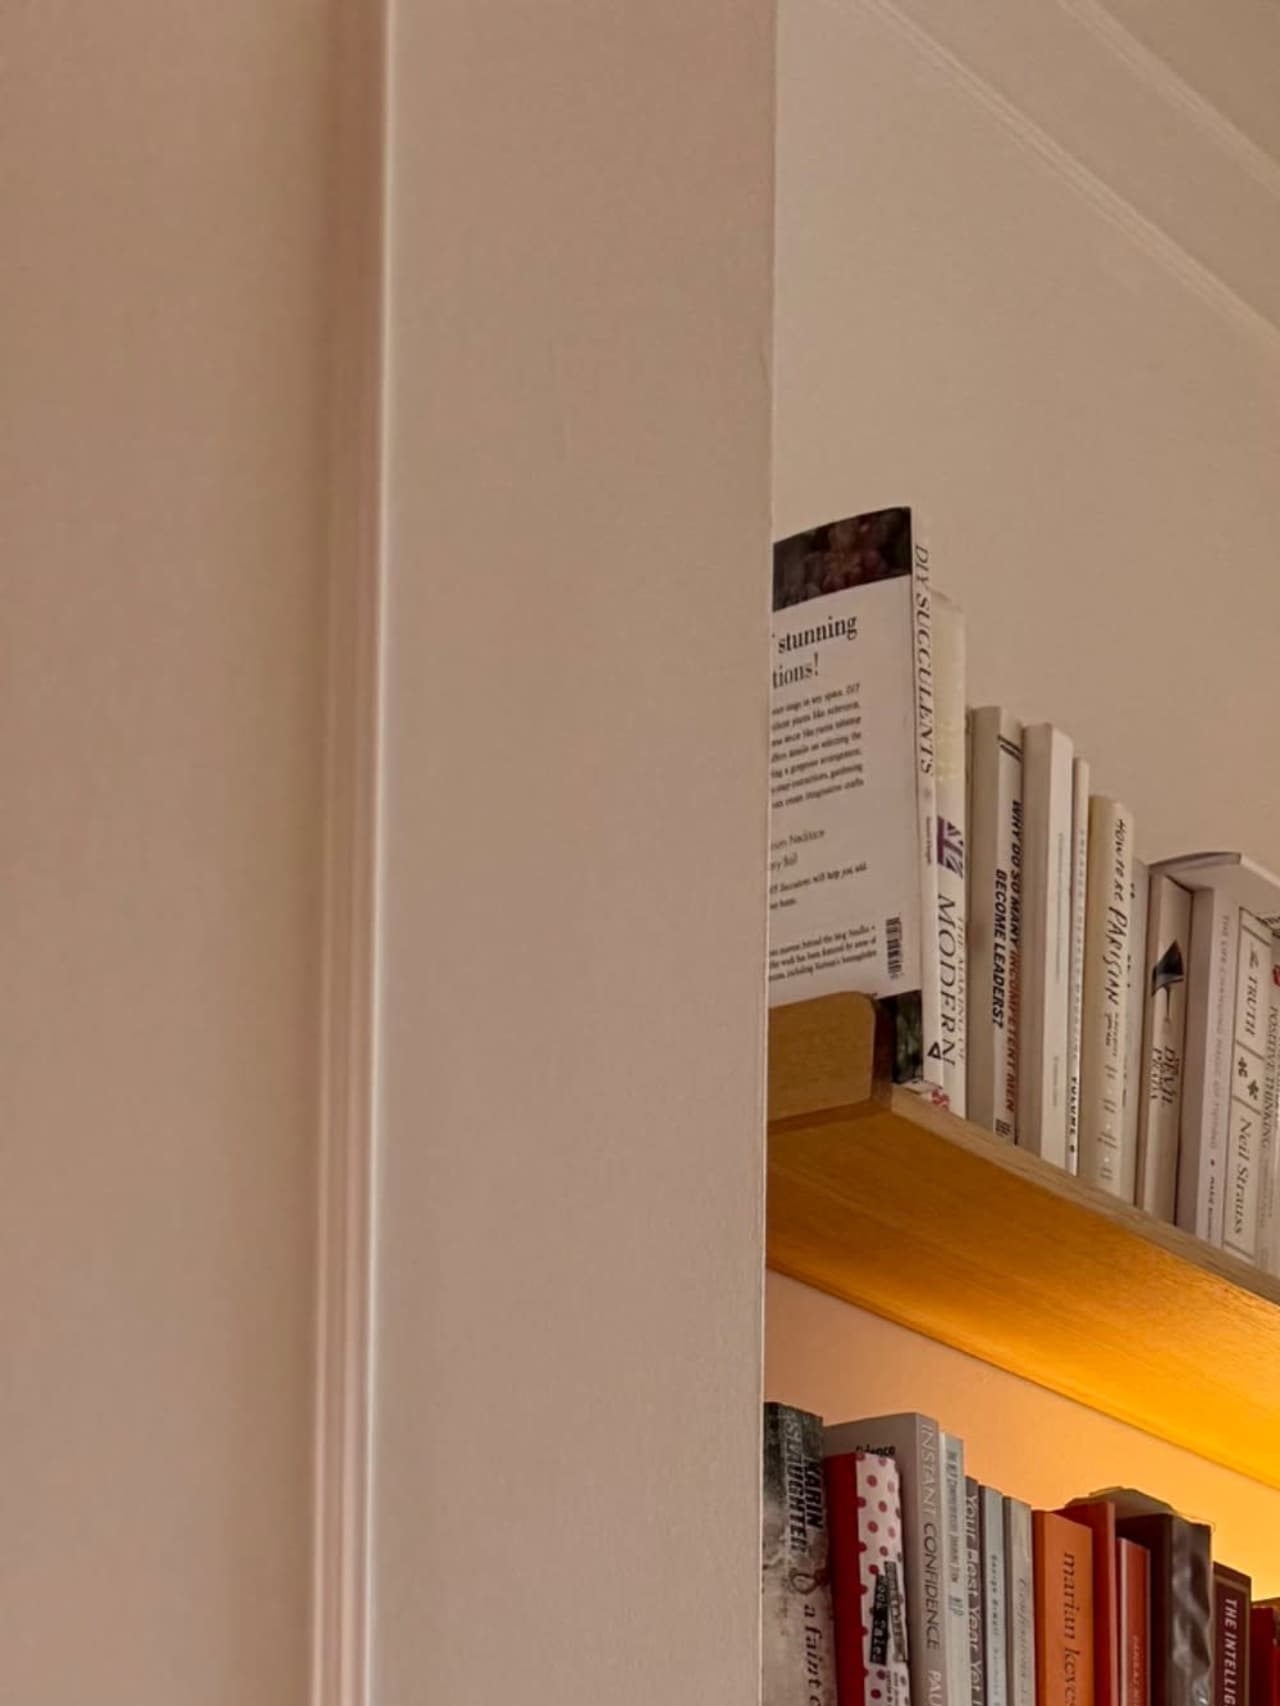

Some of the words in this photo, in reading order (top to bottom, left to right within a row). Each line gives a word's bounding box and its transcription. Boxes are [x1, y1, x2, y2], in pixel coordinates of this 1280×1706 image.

[913, 543, 930, 584] DIY
[778, 616, 858, 654] stunning
[915, 592, 935, 776] SUCCULENTS
[1011, 839, 1023, 858] DO
[1012, 800, 1024, 837] WHY
[994, 868, 1008, 941] BECOME
[1010, 865, 1022, 888] SO
[1008, 892, 1022, 946] MANY
[937, 893, 957, 1067] MODERN
[992, 943, 1006, 1029] LEADERS?
[1006, 949, 1020, 1064] INCOMPETENT
[1243, 974, 1259, 1038] TRUTH
[1005, 1068, 1017, 1112] MEN
[1239, 1118, 1253, 1158] Neil
[1233, 1165, 1248, 1236] Strauss
[785, 1418, 808, 1555] SLAUGHTER
[806, 1456, 824, 1531] KARIN
[919, 1422, 939, 1520] INSTANT
[804, 1603, 815, 1618] a
[922, 1521, 941, 1651] CONFIDENCE
[1062, 1550, 1079, 1641] marian
[1223, 1598, 1237, 1629] THE
[804, 1621, 828, 1687] faint
